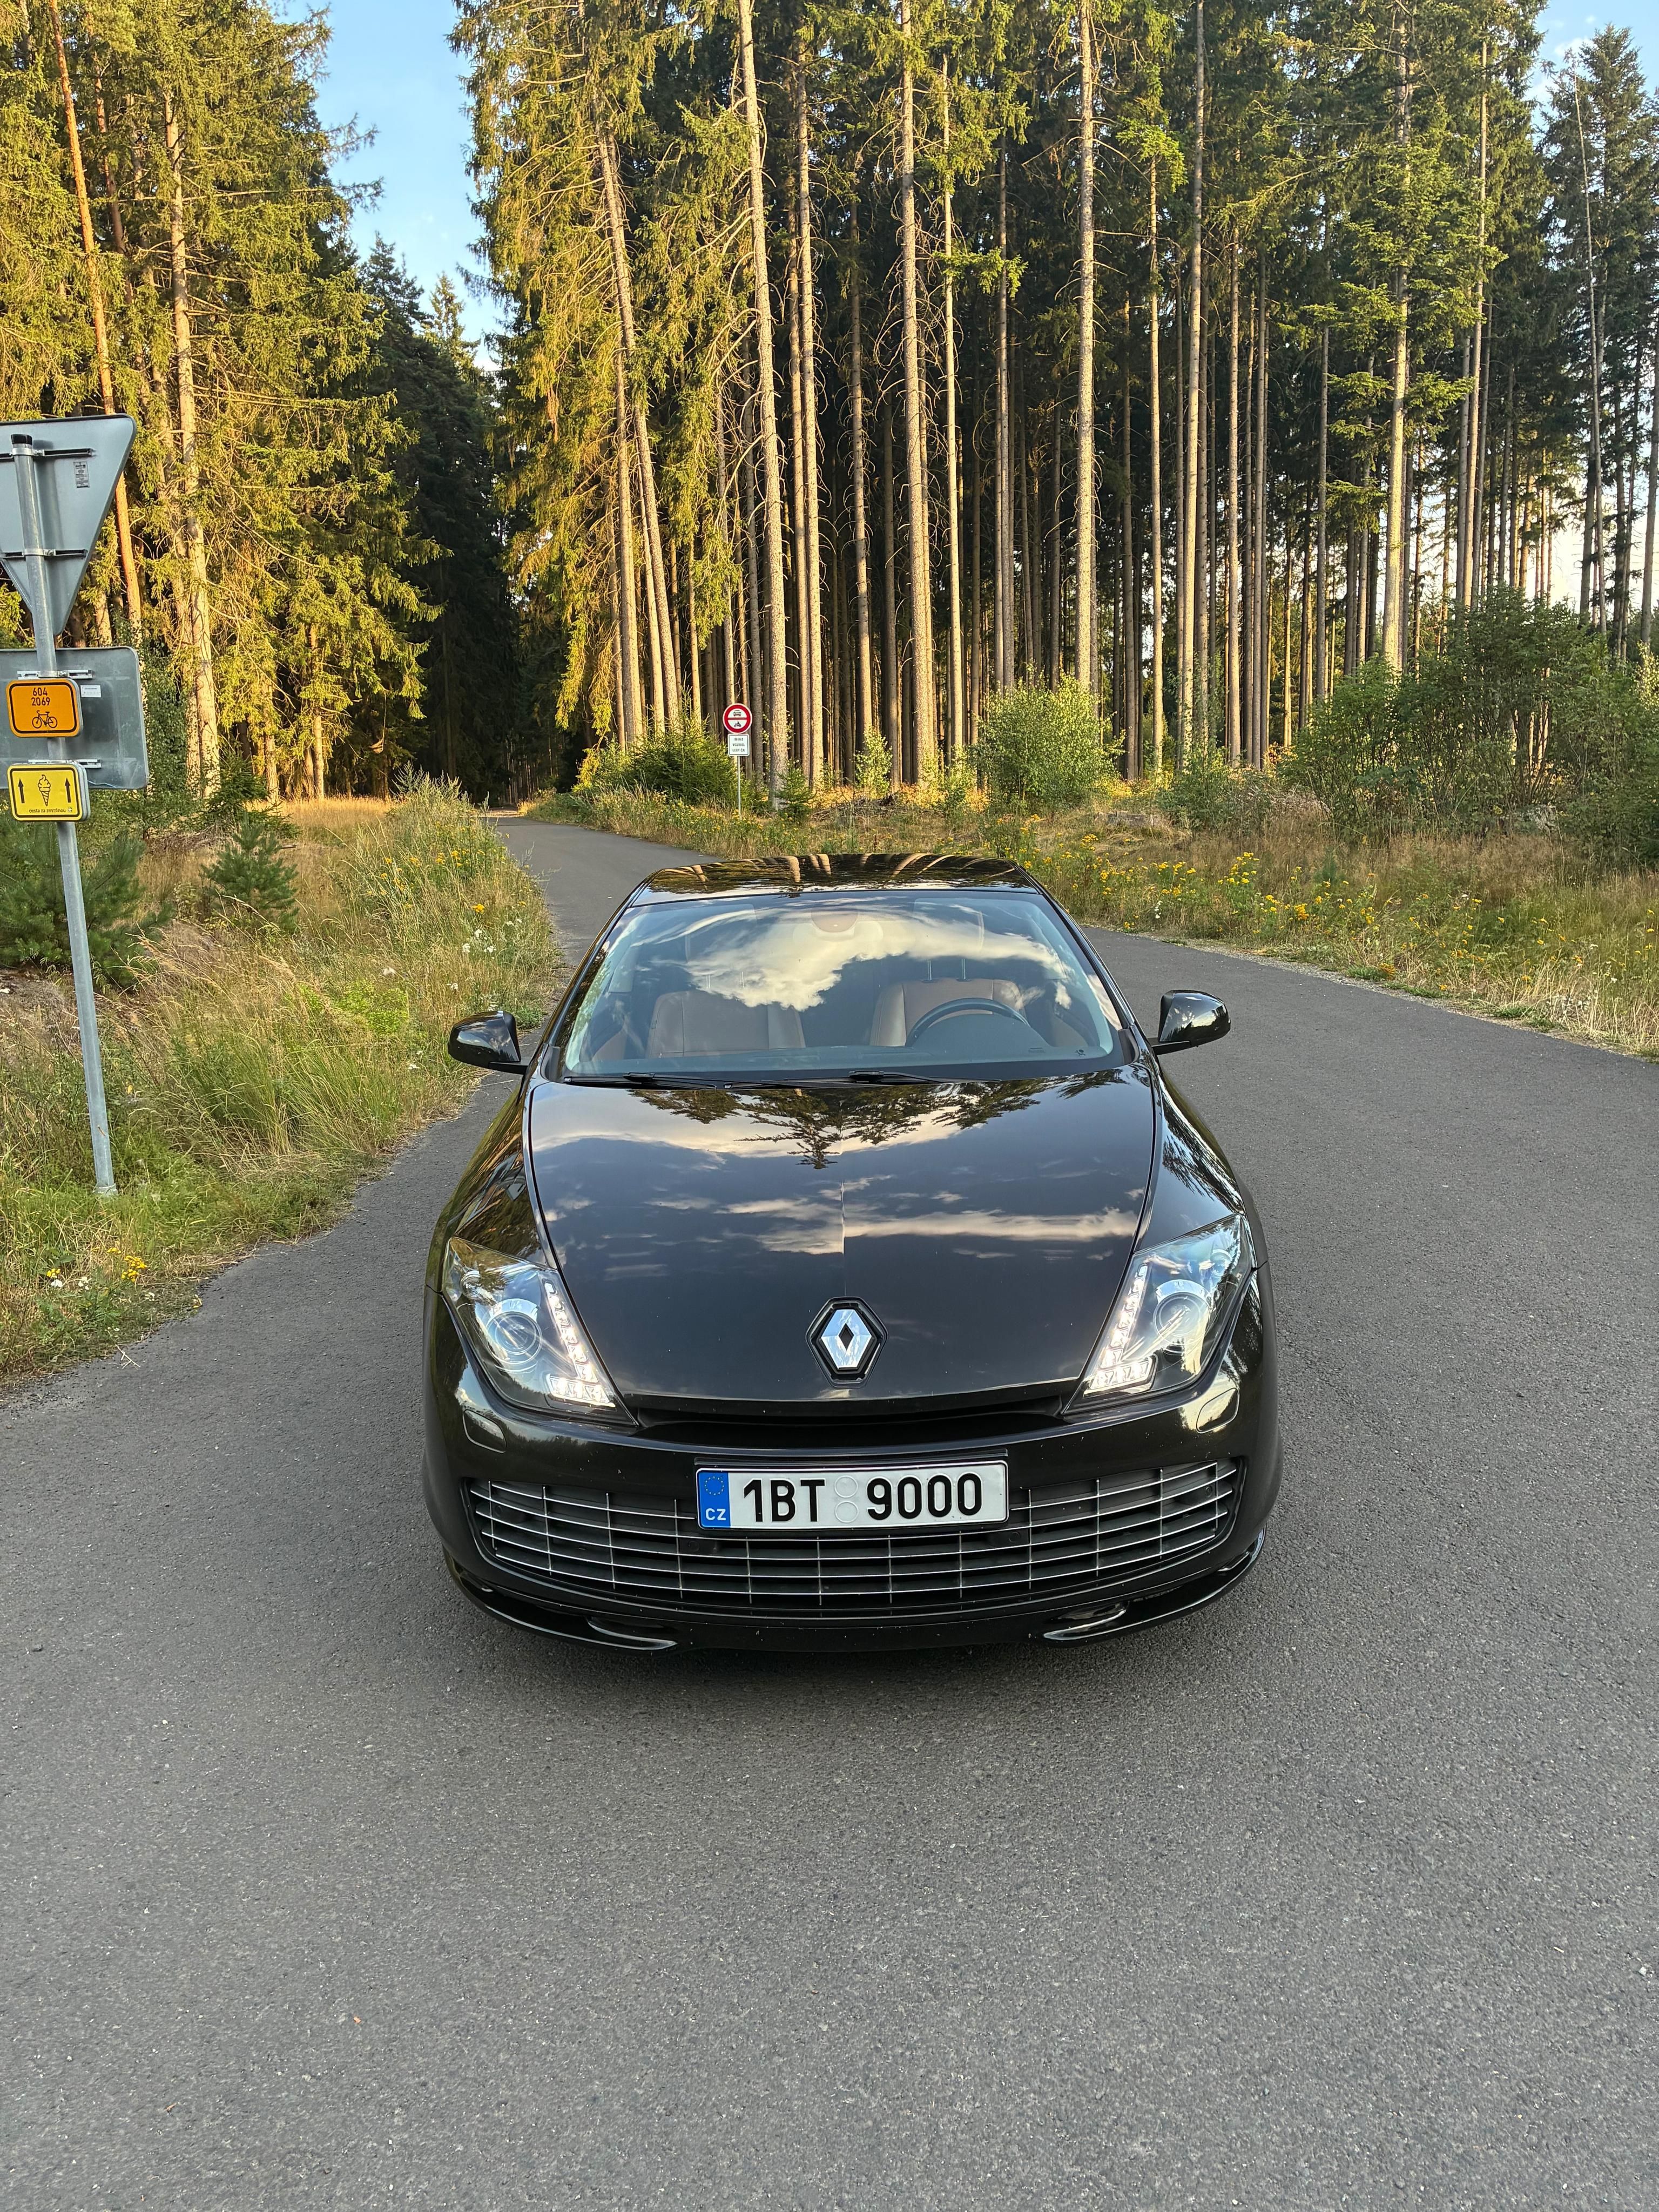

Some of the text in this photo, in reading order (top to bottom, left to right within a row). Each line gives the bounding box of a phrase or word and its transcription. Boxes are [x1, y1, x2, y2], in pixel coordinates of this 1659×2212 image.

[32, 687, 48, 696] 604
[31, 697, 50, 706] 2069
[744, 1473, 982, 1522] 1BT 9000
[705, 1508, 726, 1521] CZ
